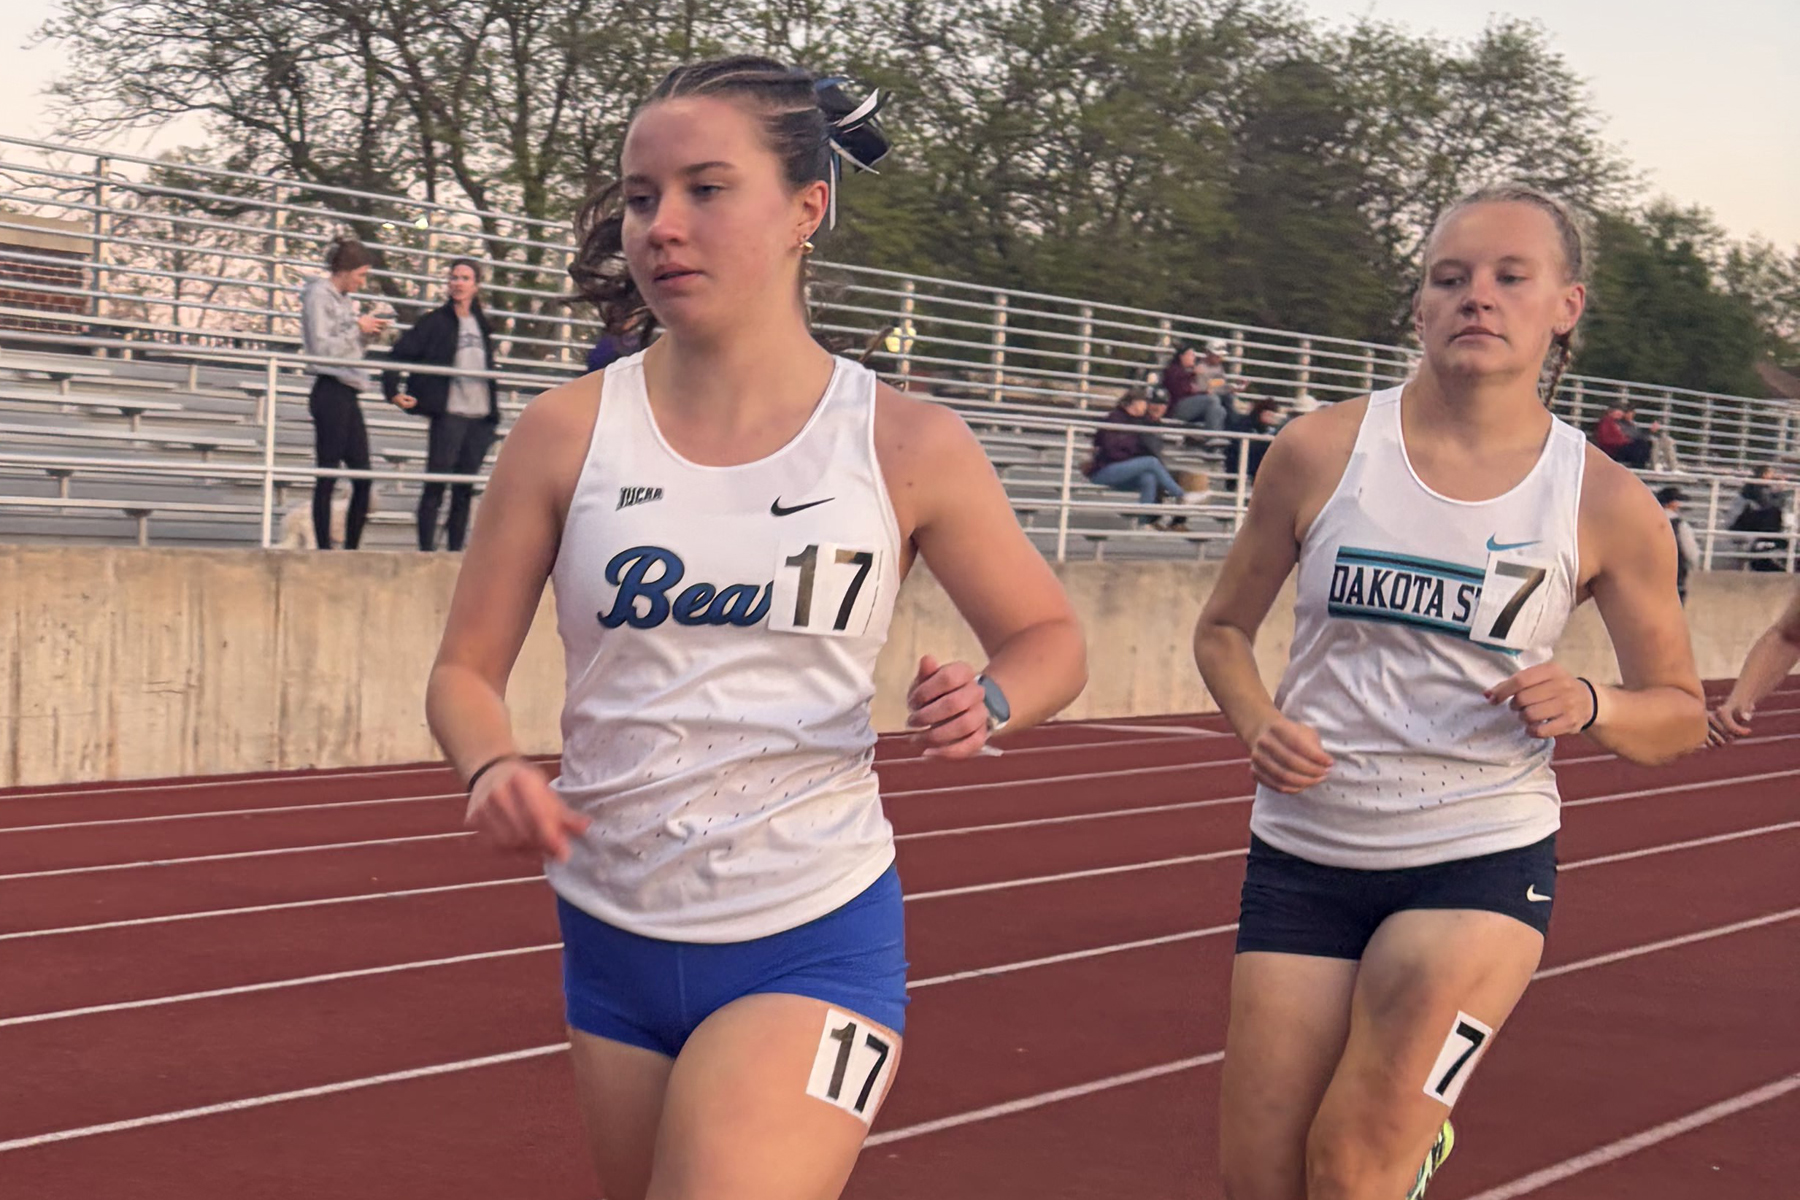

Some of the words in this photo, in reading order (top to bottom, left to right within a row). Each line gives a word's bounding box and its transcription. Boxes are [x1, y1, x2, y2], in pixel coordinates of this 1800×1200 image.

[597, 545, 774, 629] Bea
[784, 544, 873, 630] 17
[1329, 565, 1443, 618] DAKOTA
[1488, 560, 1547, 639] 7
[826, 1021, 889, 1114] 17
[1435, 1020, 1486, 1096] 7
